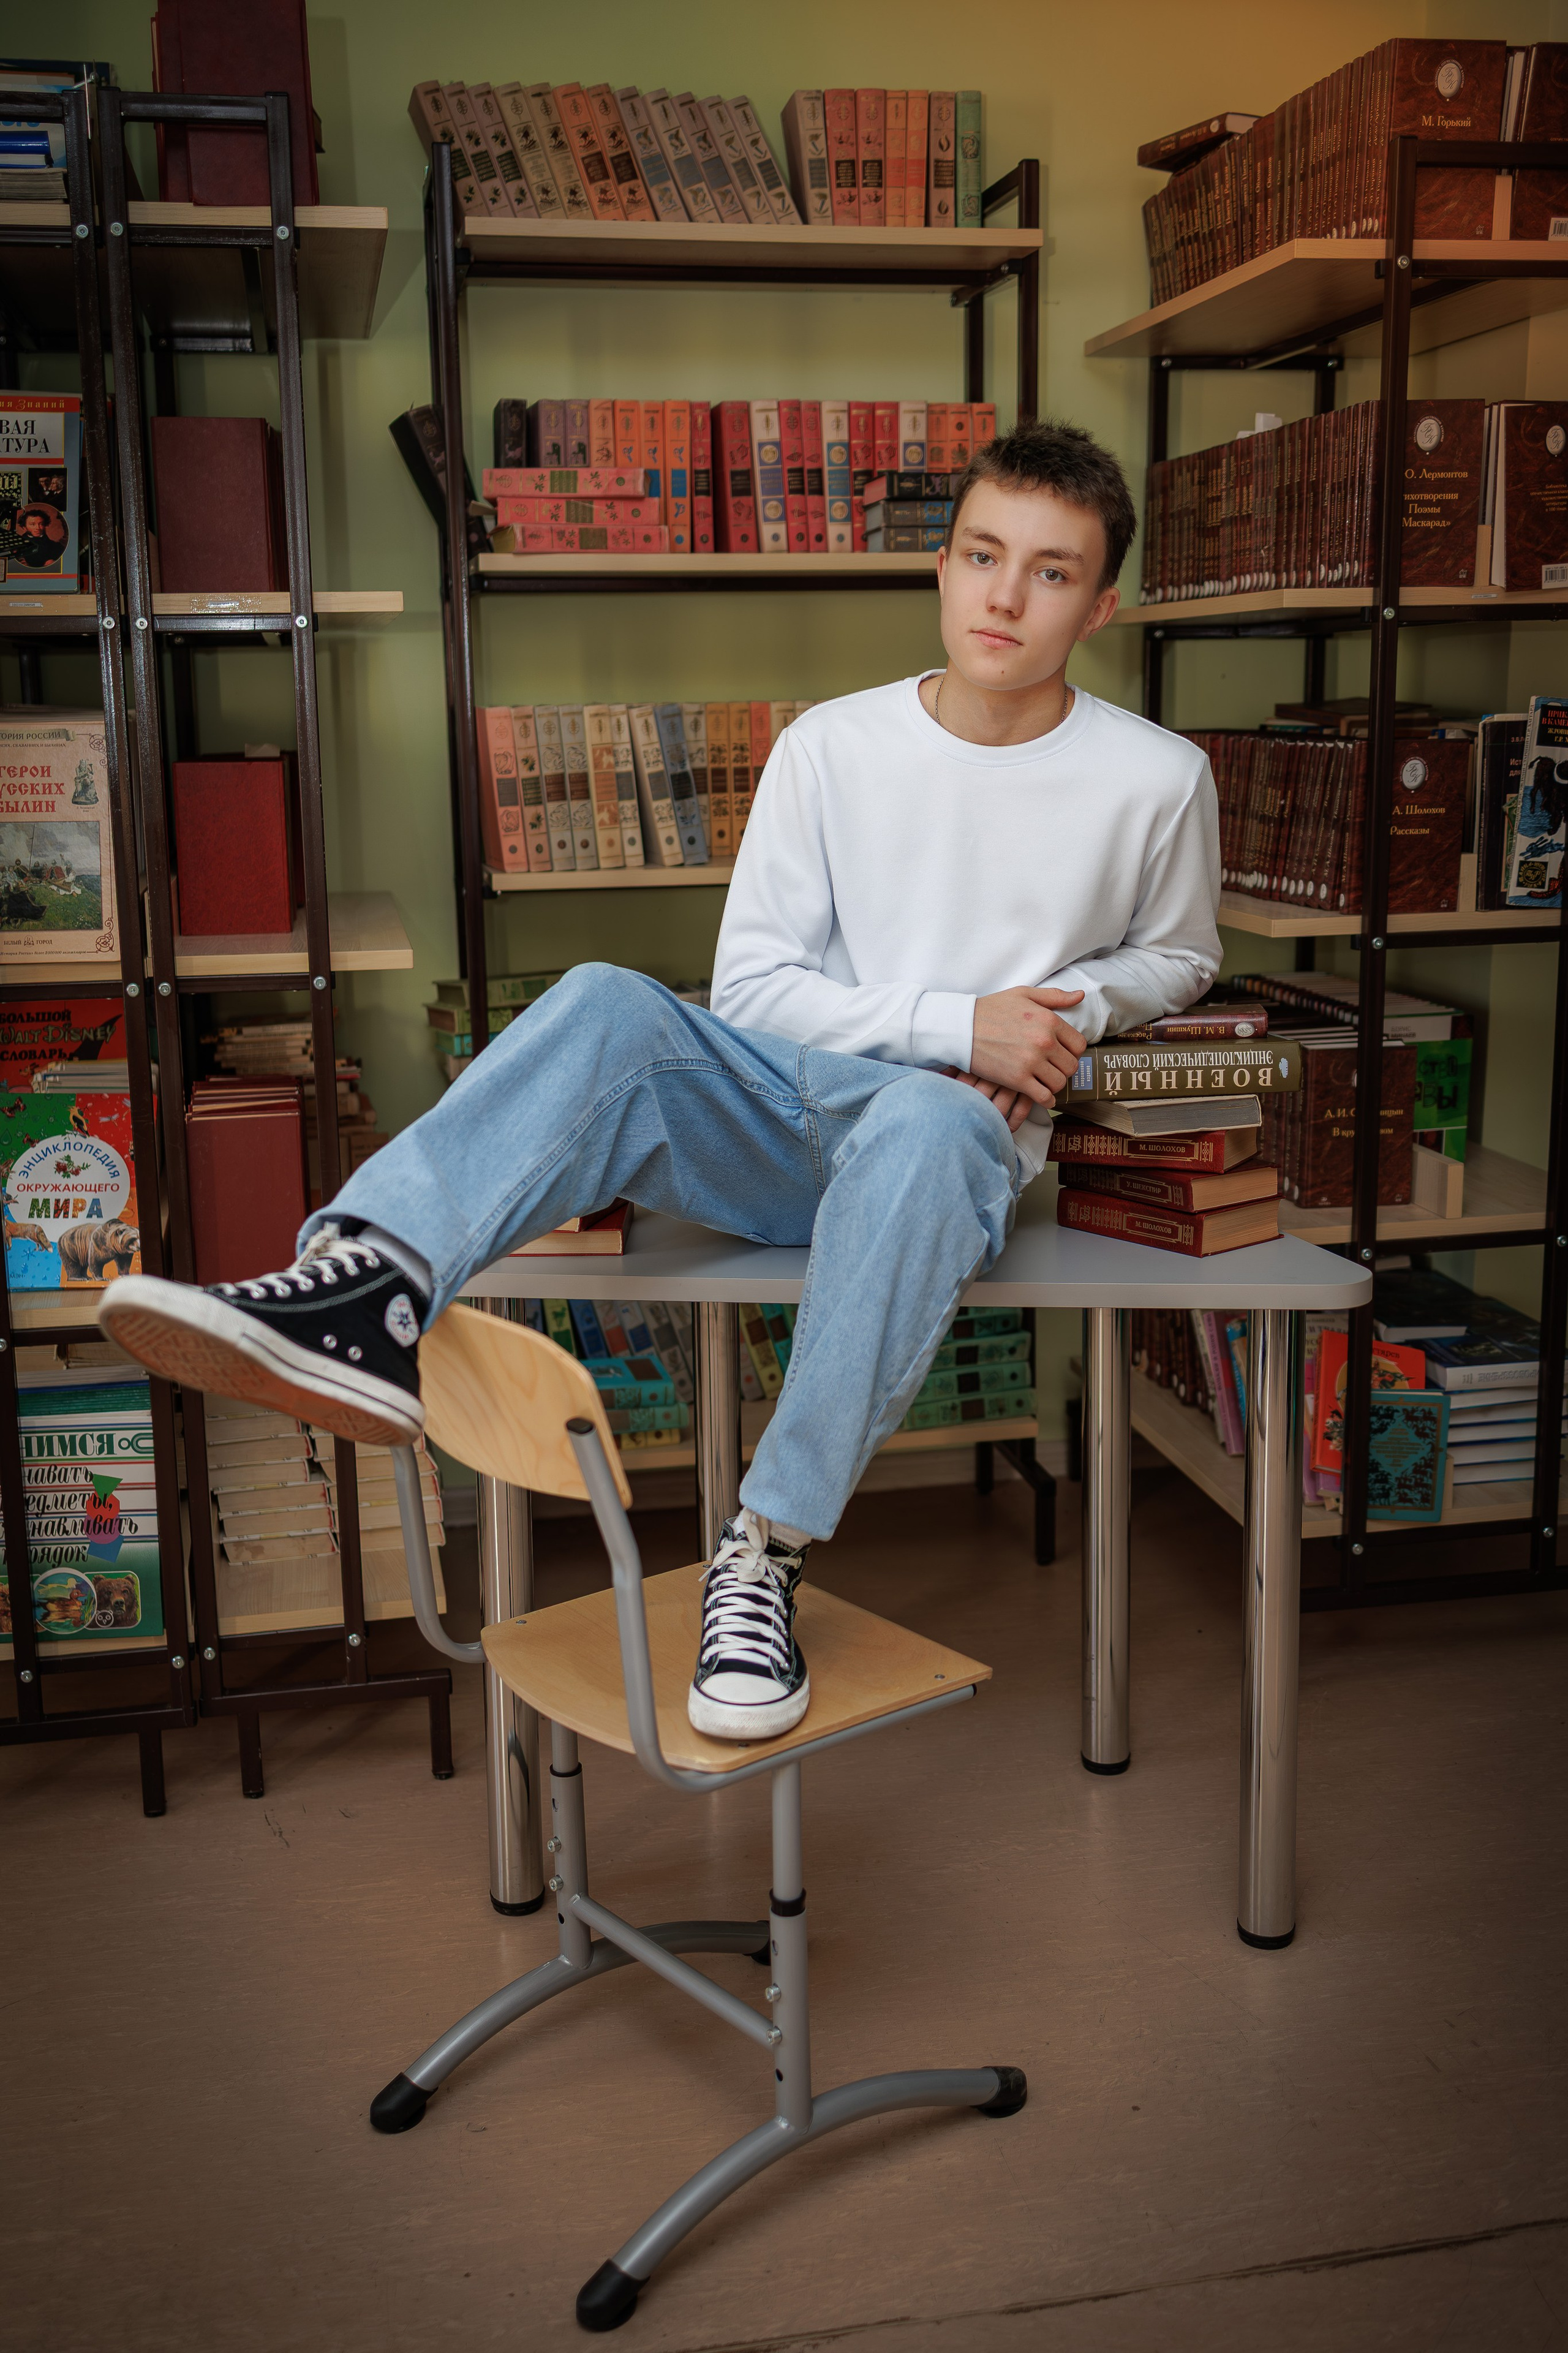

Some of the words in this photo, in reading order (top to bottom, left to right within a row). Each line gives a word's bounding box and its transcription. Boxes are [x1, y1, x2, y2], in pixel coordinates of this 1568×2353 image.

[1422, 116, 1434, 127] М.
[1437, 116, 1471, 129] Горький
[15, 399, 64, 411] Знаний
[0, 437, 50, 453] ТУРА
[1419, 469, 1468, 480] Лермонтов
[1409, 504, 1441, 513] Поэмы
[1402, 517, 1452, 527] Маскарад»
[1548, 709, 1568, 718] ПРИК
[0, 765, 52, 778] ГЕРОИ
[1392, 806, 1403, 815] А.
[1406, 805, 1446, 815] Шолохов
[1390, 826, 1430, 836] Рассказы
[1167, 1026, 1202, 1035] Шукшин
[0, 1048, 67, 1061] СЛОВАРЬ
[1104, 1053, 1150, 1068] СЛОВАРЬ
[1152, 1048, 1273, 1071] ЭНЦИКЛОПЕДИЧЕСКИЙ
[1104, 1068, 1273, 1095] ВОЕННЫЙ
[1324, 1109, 1335, 1119] А.
[1337, 1108, 1348, 1118] И.
[1332, 1127, 1340, 1137] В
[1148, 1144, 1186, 1153] ШОЛОХОВ
[18, 1141, 120, 1179] ЭНЦИКЛОПЕДИЯ
[17, 1183, 120, 1194] ОКРУЖАЮЩЕГО
[1133, 1182, 1161, 1194] ШЕКСПИР
[28, 1198, 104, 1218] МИРА
[1142, 1222, 1172, 1234] ШОЛОХОВ
[26, 1493, 113, 1517] едметы,
